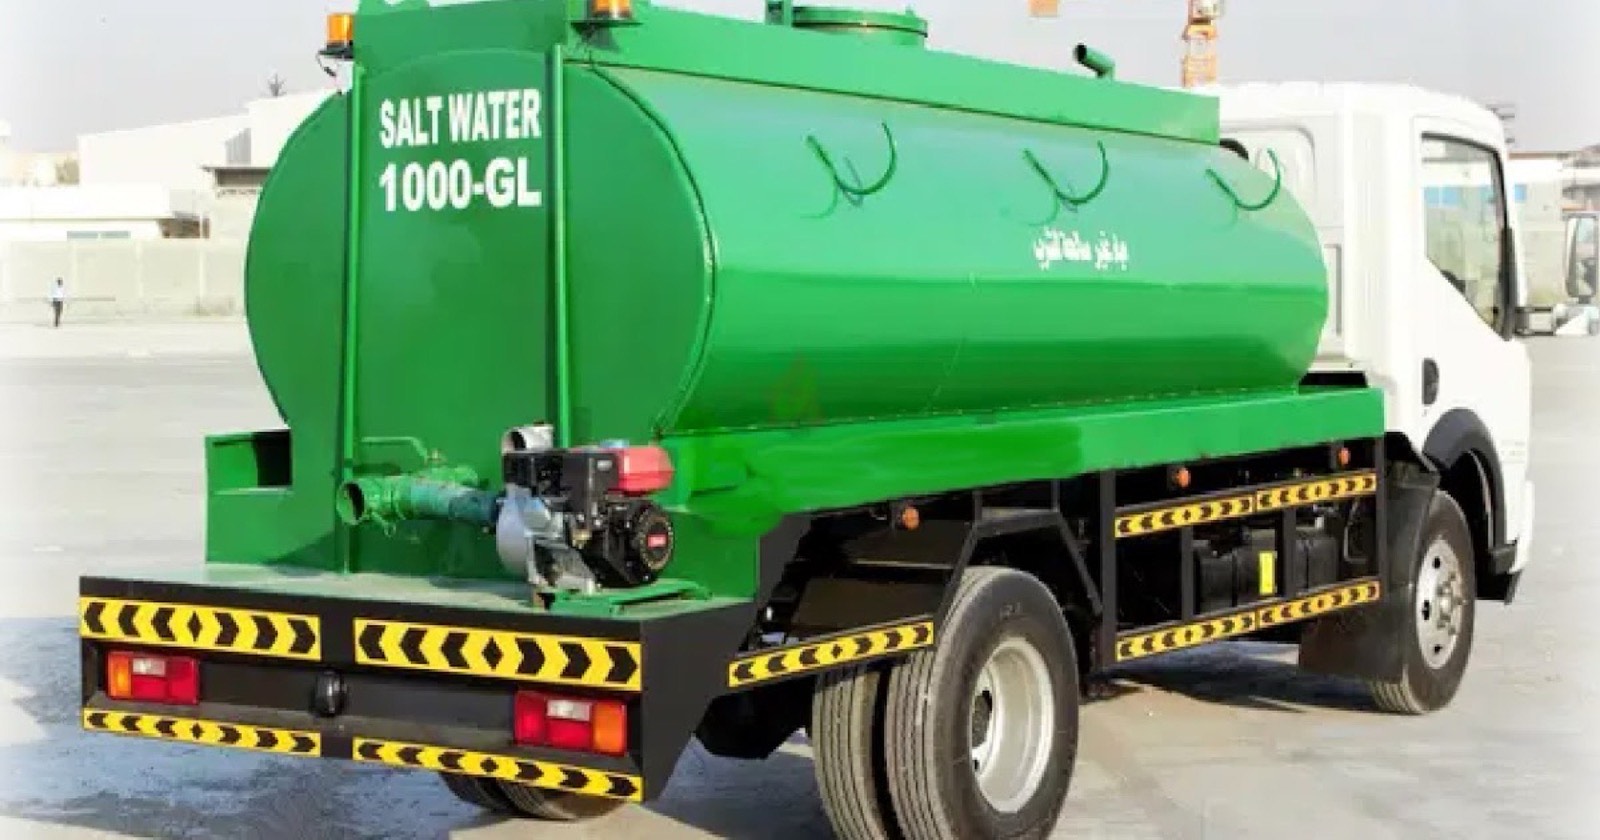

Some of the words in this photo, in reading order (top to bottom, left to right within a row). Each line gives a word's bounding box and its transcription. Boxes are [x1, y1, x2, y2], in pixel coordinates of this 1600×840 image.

[379, 95, 443, 148] SALT
[448, 88, 542, 143] WATER
[379, 155, 543, 212] 1000-GL
